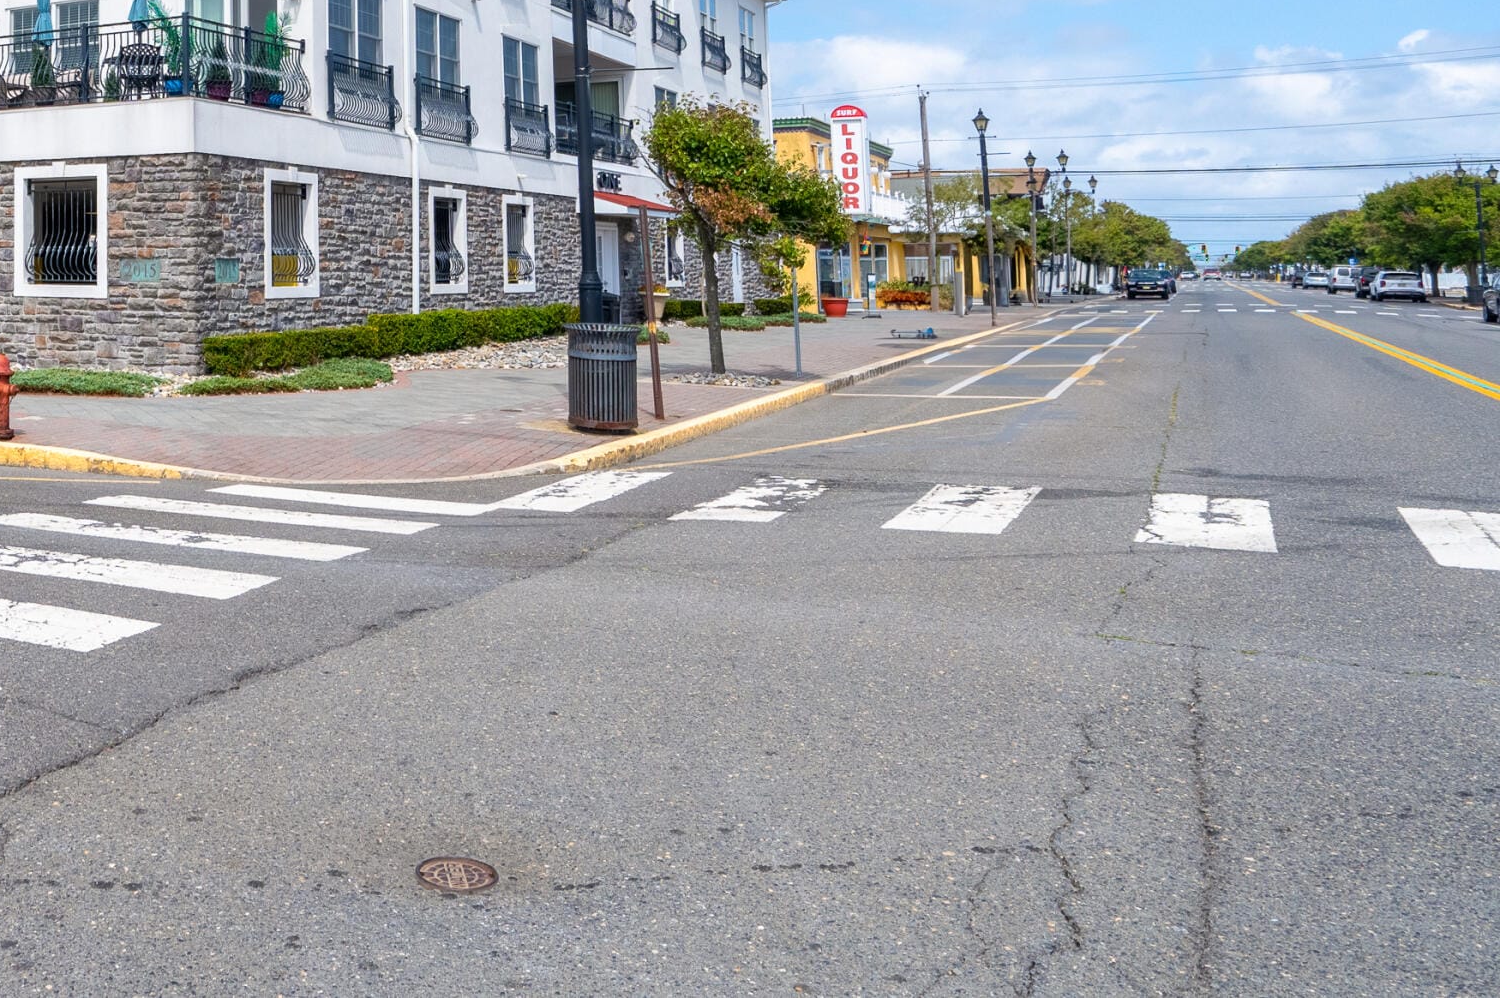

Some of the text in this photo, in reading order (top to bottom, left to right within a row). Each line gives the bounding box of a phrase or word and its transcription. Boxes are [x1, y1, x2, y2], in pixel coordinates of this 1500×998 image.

[836, 109, 858, 117] SURF
[841, 123, 860, 209] LIQUOR
[597, 171, 622, 191] ONE
[124, 263, 157, 278] 2015
